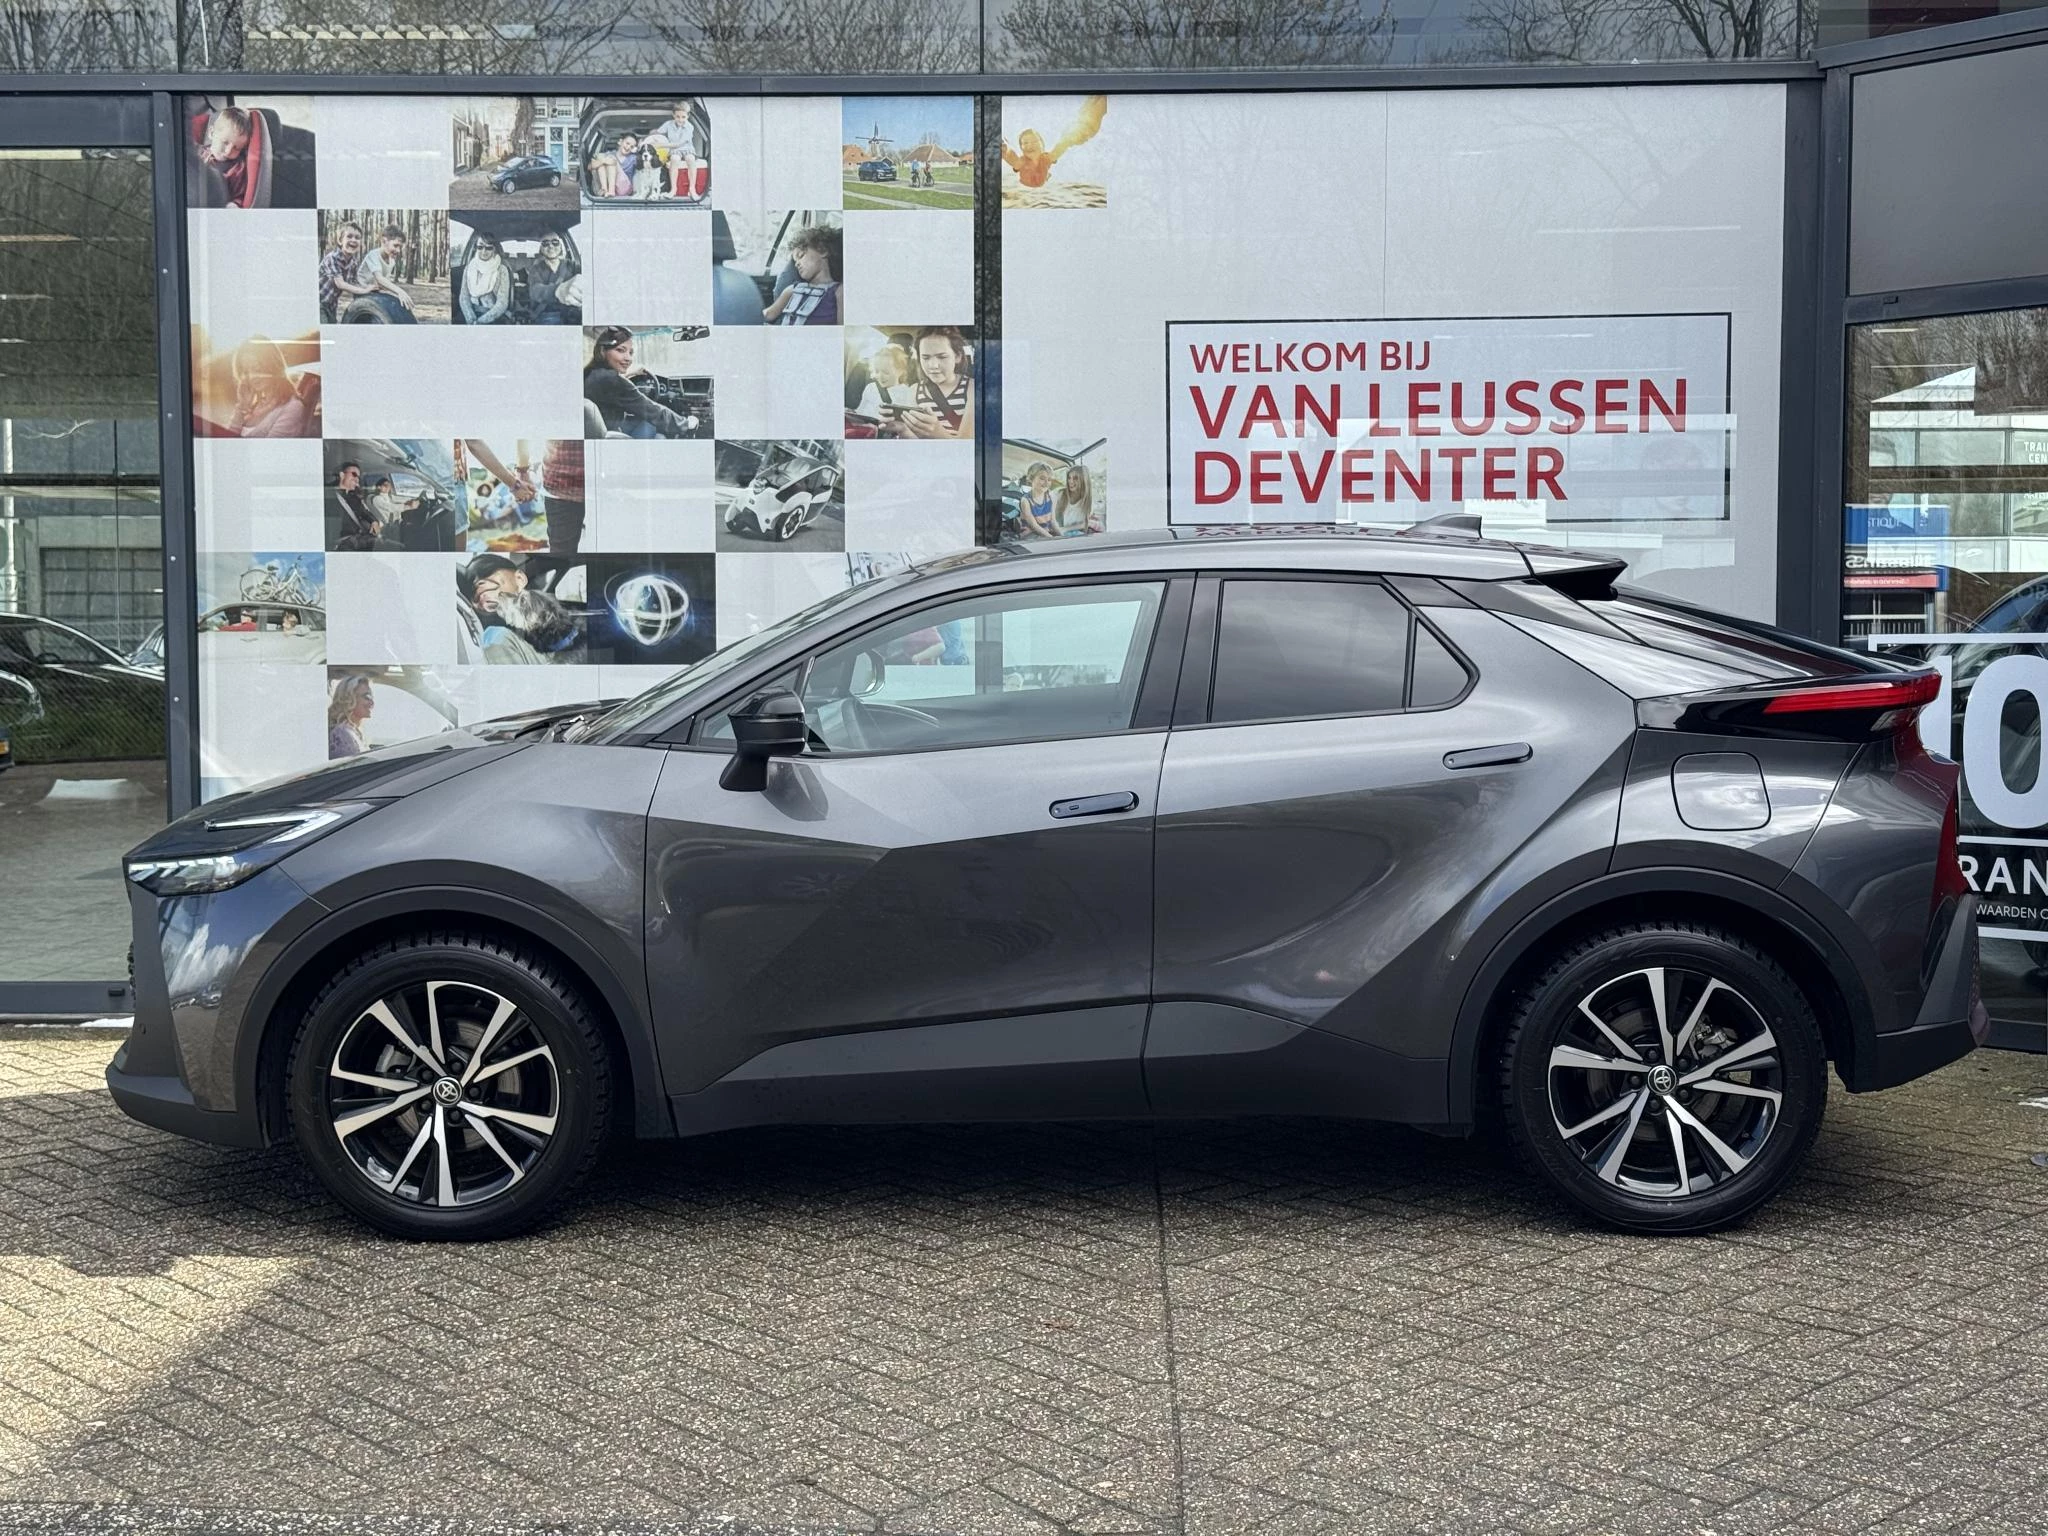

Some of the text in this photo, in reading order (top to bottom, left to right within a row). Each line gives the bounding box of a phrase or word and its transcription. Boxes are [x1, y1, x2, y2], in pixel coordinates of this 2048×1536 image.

[1190, 341, 1431, 373] WELKOM BIJ
[1189, 378, 1687, 439] VAN LEUSSEN
[1194, 447, 1568, 504] DEVENTER
